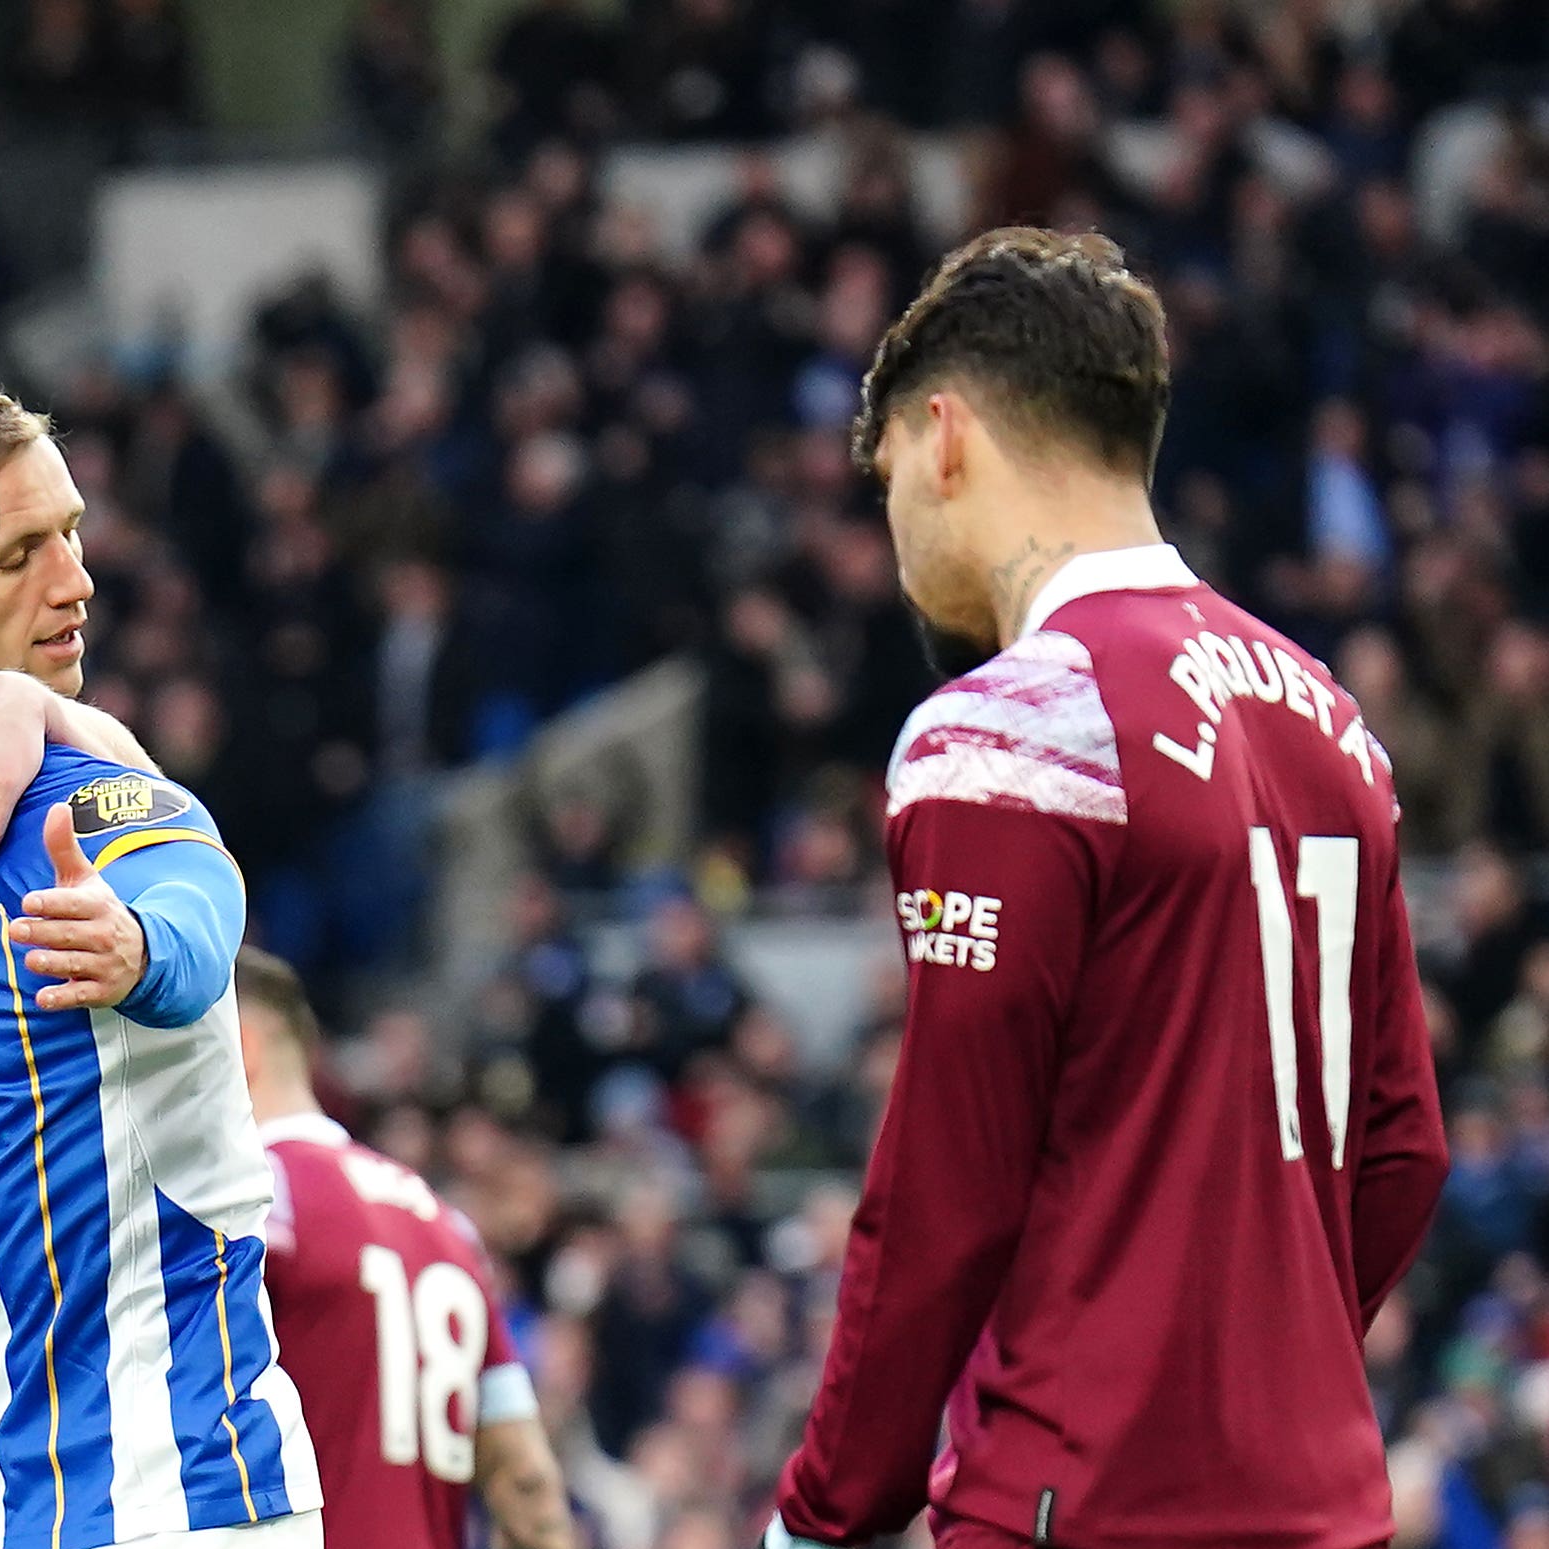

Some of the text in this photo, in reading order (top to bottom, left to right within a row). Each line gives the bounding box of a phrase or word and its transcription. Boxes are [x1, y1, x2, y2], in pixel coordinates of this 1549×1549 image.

[105, 790, 144, 812] UK
[1249, 826, 1359, 1169] 11
[359, 1244, 488, 1485] 18
